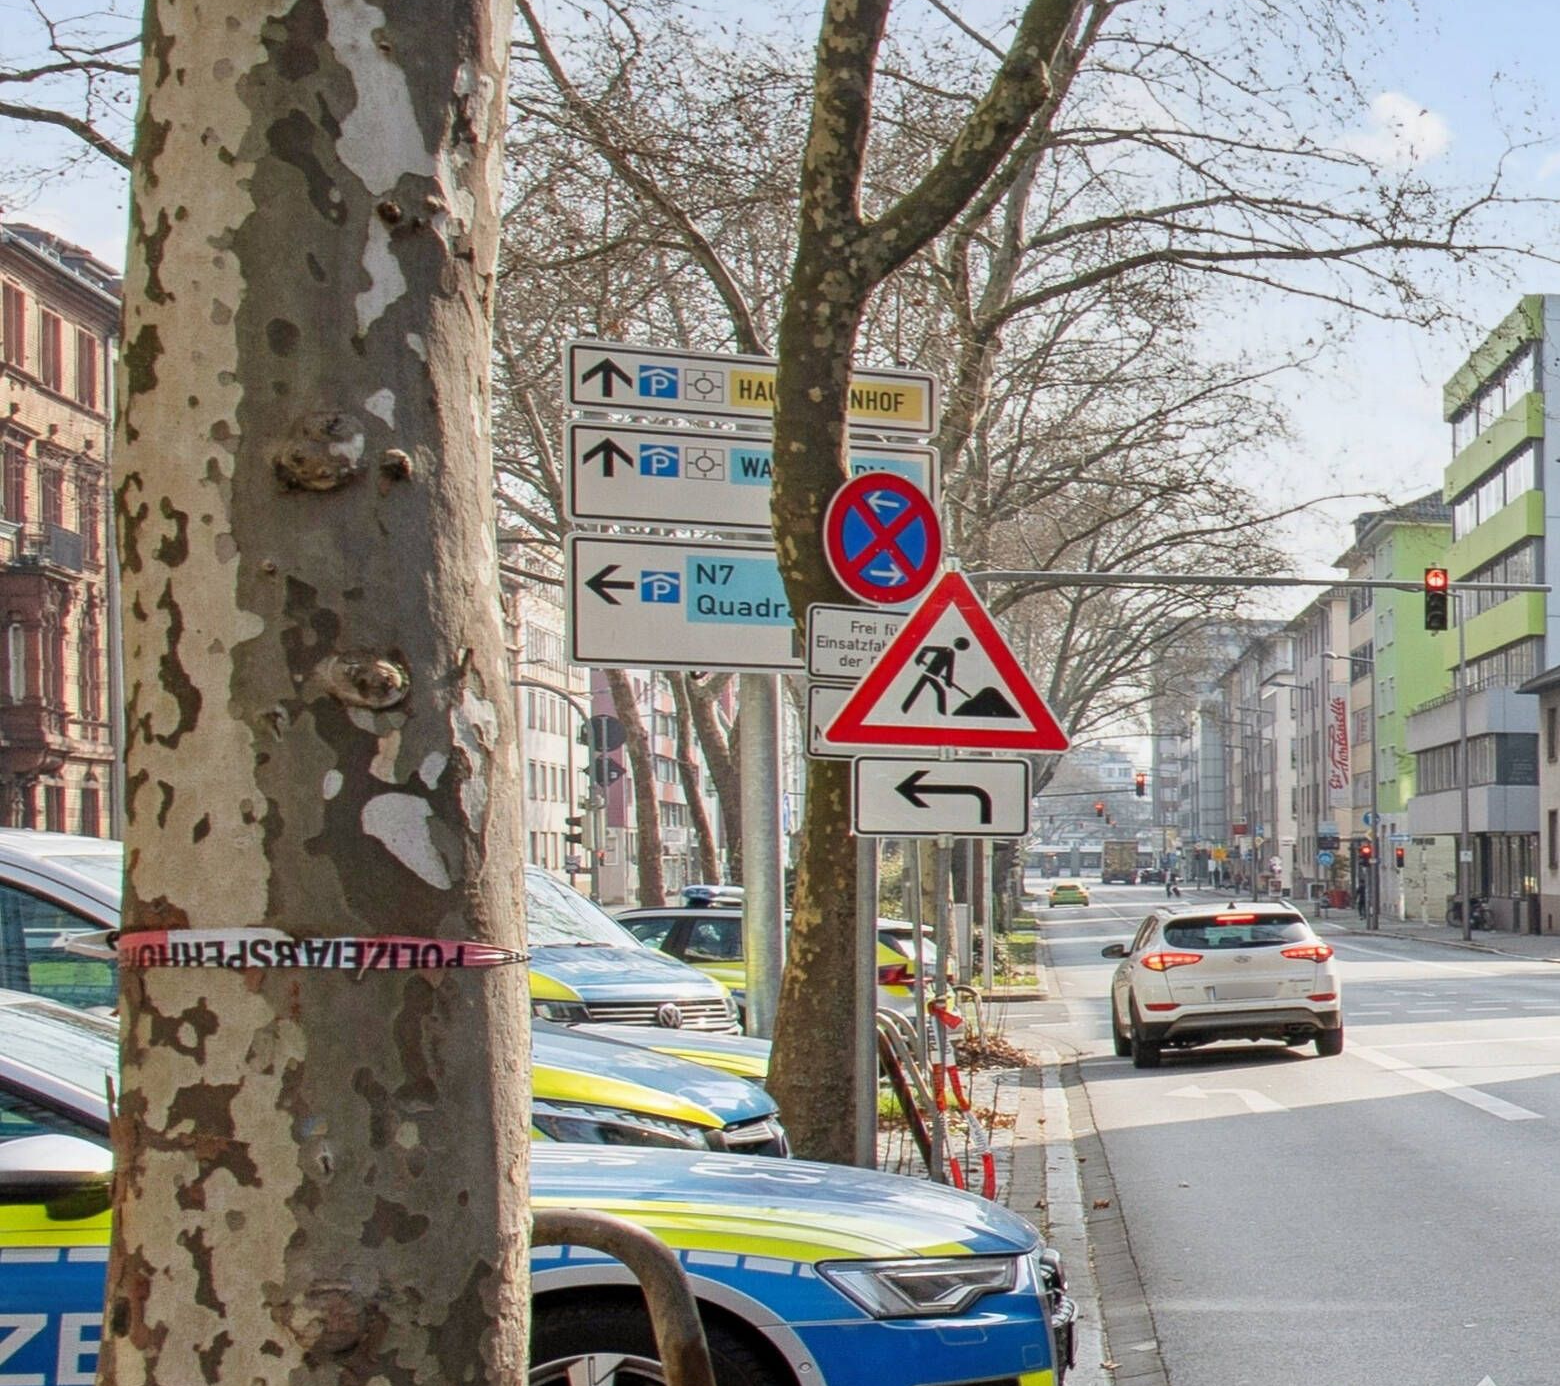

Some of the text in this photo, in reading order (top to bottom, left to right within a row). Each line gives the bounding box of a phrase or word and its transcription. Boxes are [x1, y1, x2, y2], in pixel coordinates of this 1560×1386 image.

[697, 563, 735, 585] N7
[851, 621, 898, 636] Frei fü
[839, 655, 863, 668] der
